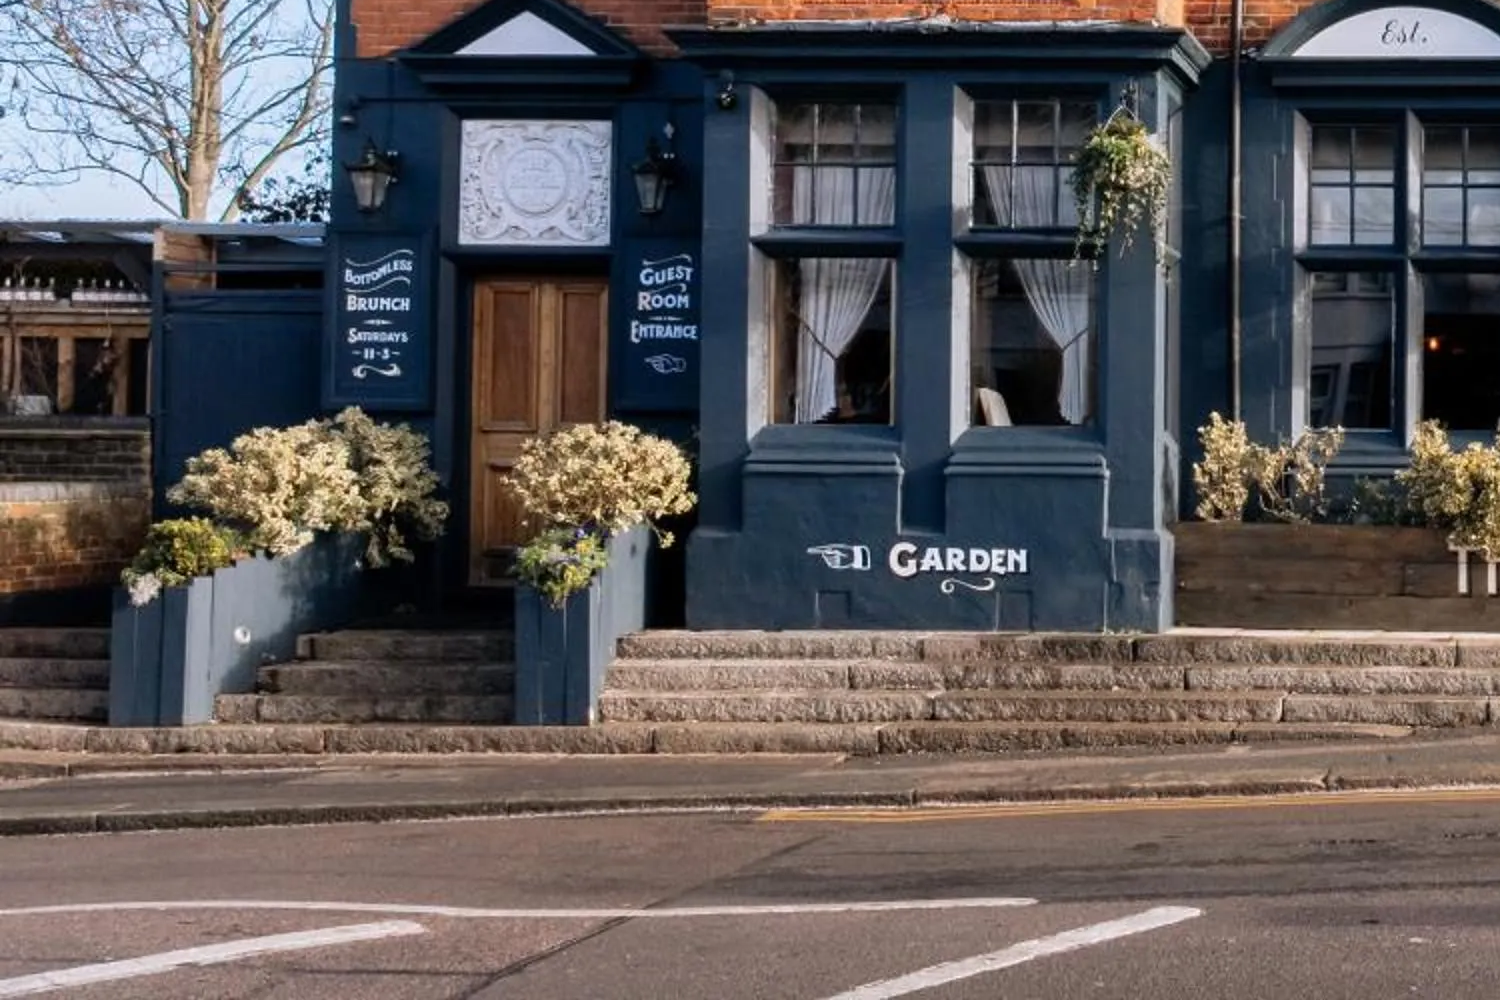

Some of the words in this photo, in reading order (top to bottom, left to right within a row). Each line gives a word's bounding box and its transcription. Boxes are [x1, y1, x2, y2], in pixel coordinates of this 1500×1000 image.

[1381, 19, 1427, 47] Est.
[344, 260, 413, 285] BOTTOMLESS
[640, 265, 693, 285] GUEST
[346, 294, 411, 311] BRUNCH
[638, 291, 690, 311] ROOM
[347, 328, 409, 344] SATURDAYS
[631, 319, 698, 344] ENTRANCE
[889, 541, 1028, 577] GARDEN
